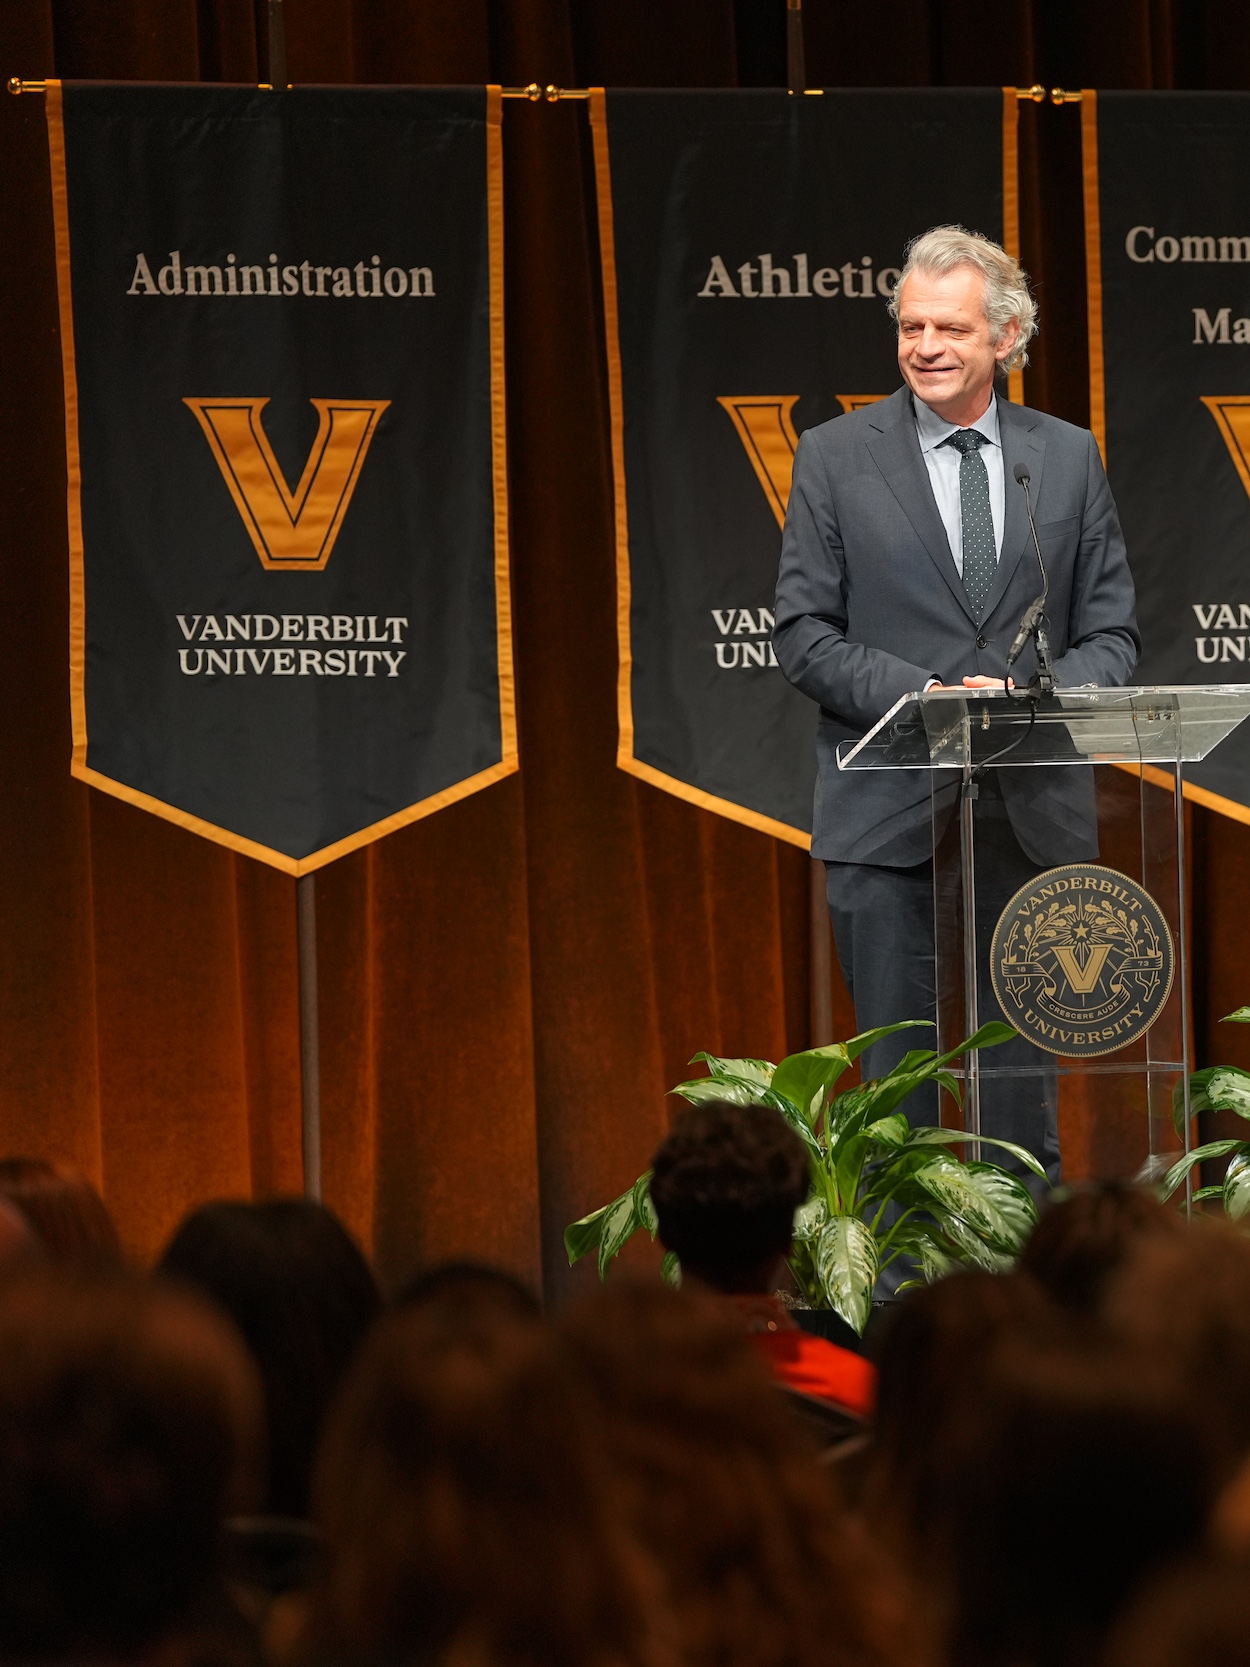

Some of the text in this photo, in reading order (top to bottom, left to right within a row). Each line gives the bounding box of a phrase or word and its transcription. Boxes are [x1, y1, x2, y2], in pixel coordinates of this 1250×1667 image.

[126, 250, 436, 297] Administration
[697, 252, 903, 298] Athletic
[182, 396, 392, 571] V
[175, 614, 409, 644] VANDERBILT
[177, 648, 408, 678] UNIVERSITY
[1017, 876, 1143, 918] VANDERBILT
[1050, 943, 1114, 994] V
[1137, 959, 1150, 968] 73
[1023, 1001, 1144, 1045] UNIVERSITY
[1048, 1000, 1119, 1020] CRESCERE AUDE
